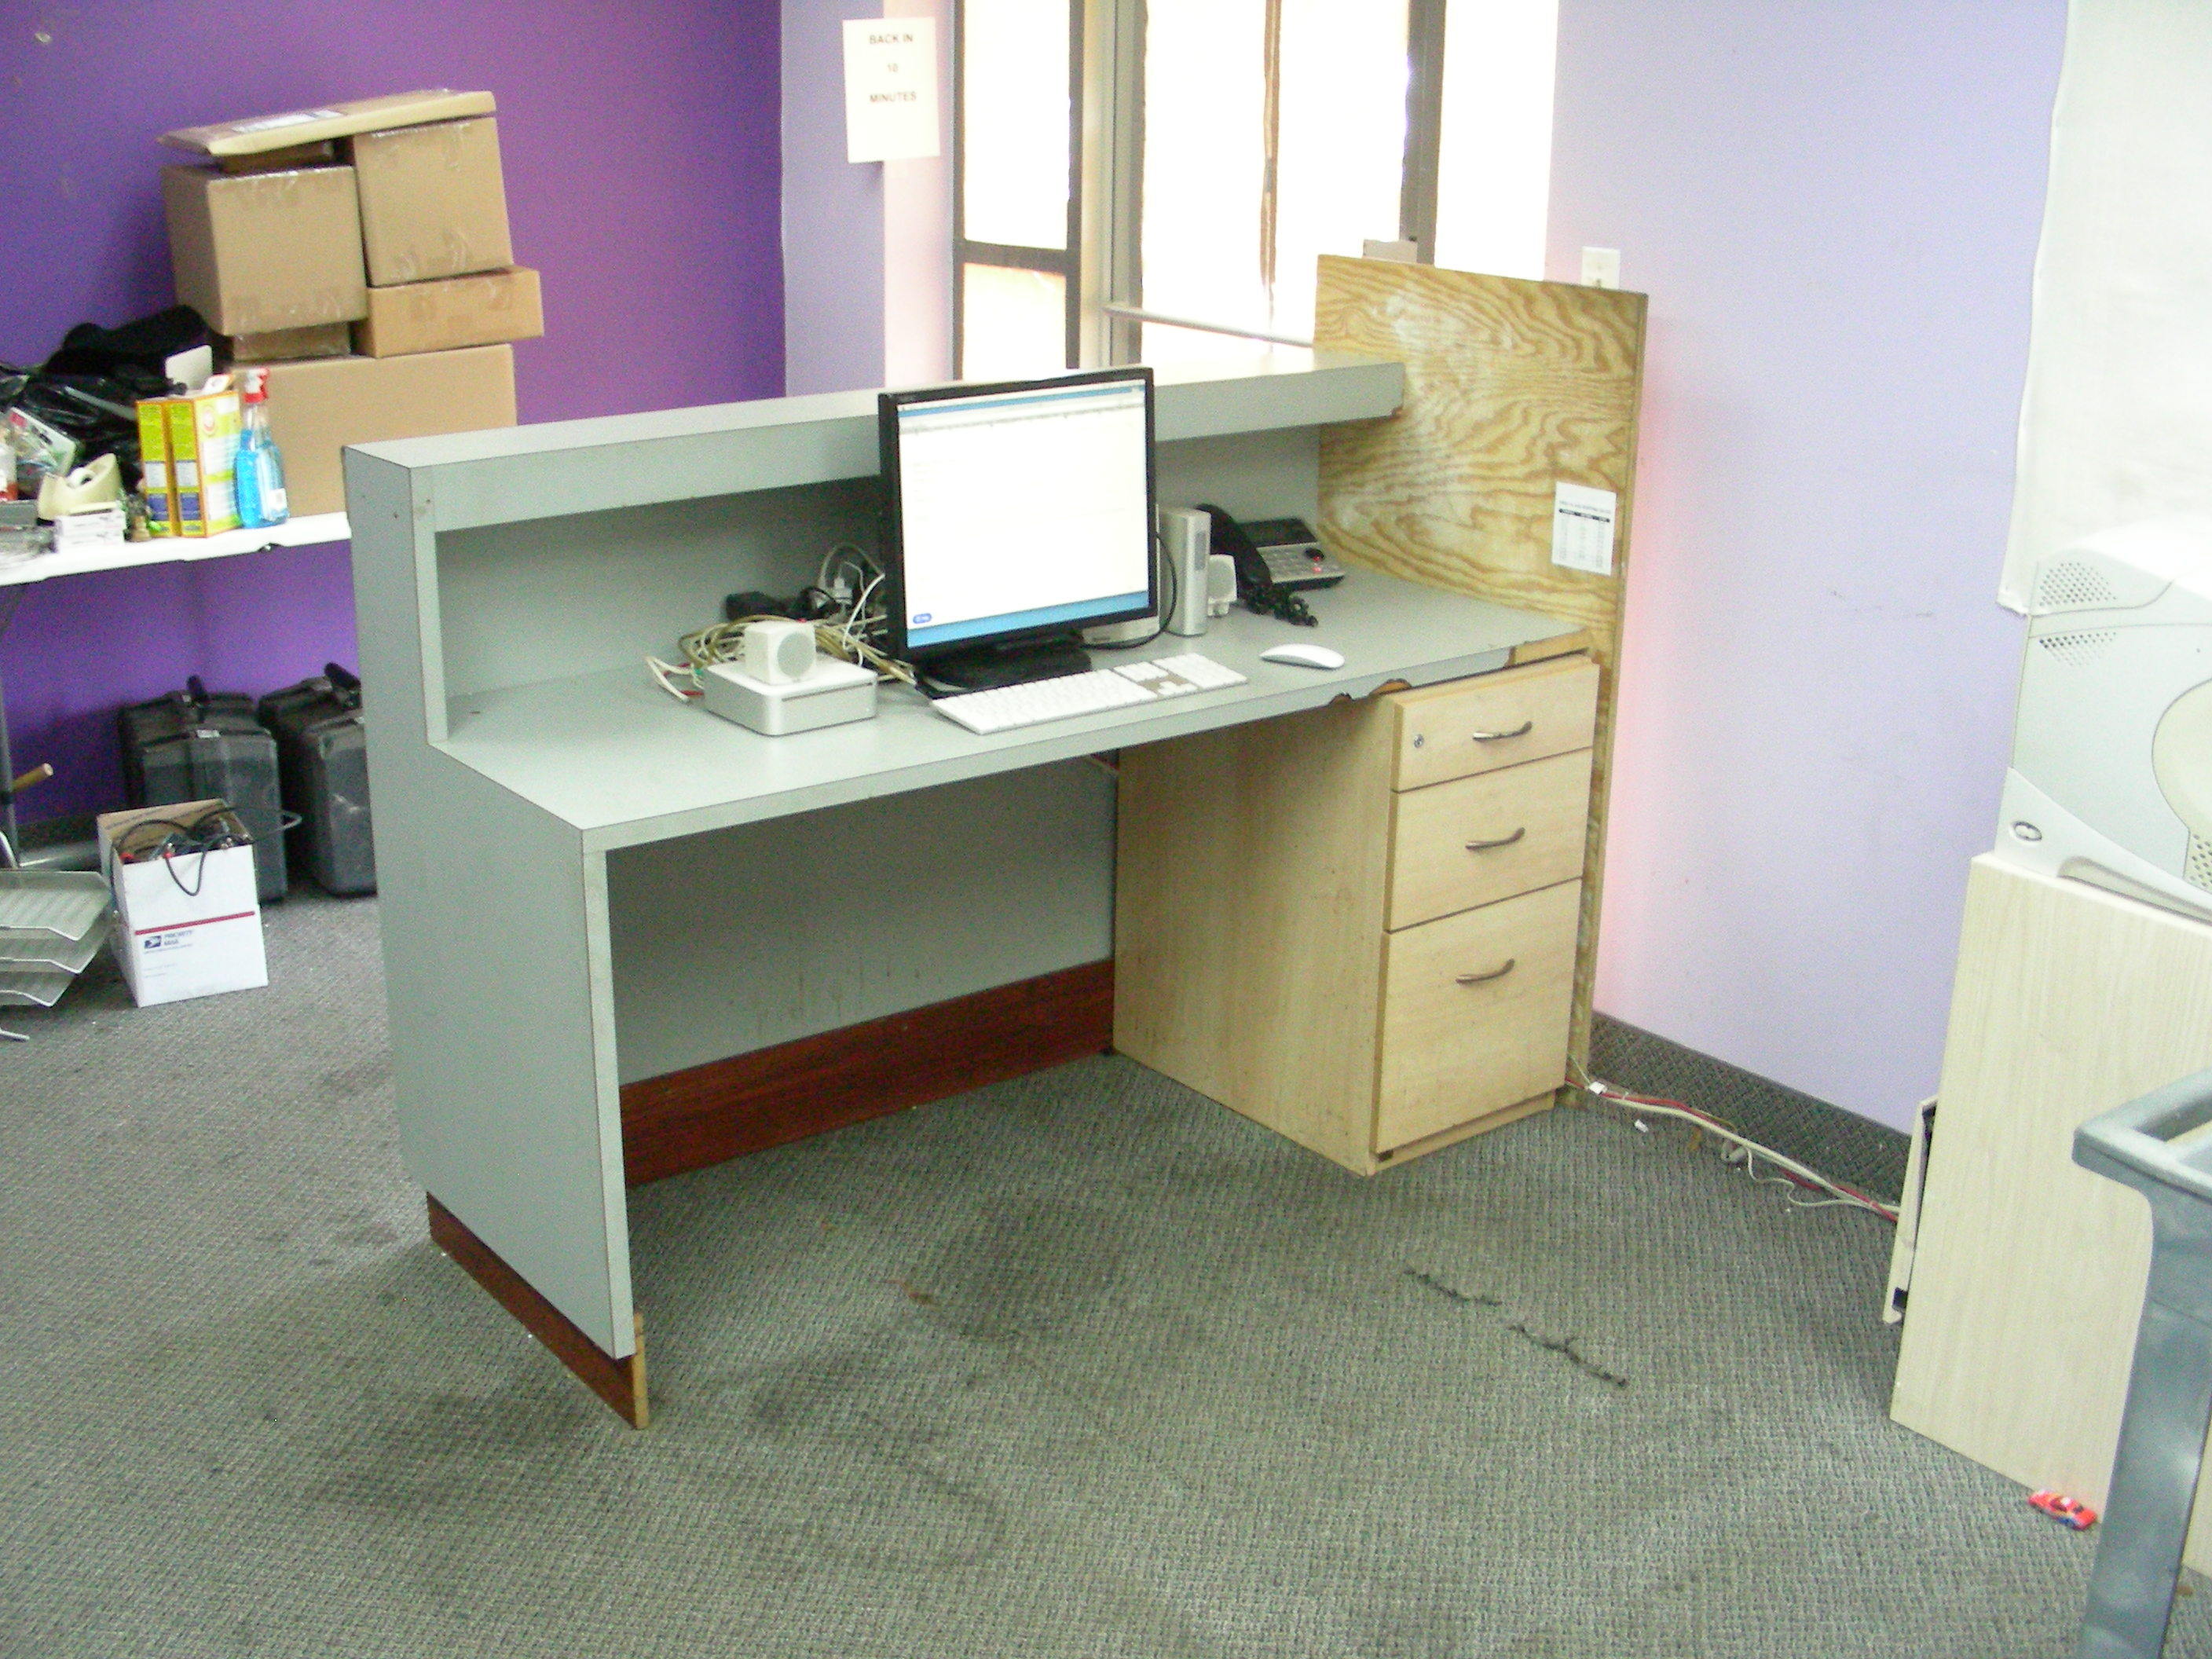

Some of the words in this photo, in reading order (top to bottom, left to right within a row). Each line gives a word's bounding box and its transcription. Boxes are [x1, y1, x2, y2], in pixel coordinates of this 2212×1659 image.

[869, 34, 899, 44] BACK
[903, 34, 914, 42] IN
[887, 64, 899, 73] 10
[869, 91, 917, 102] MINUTES
